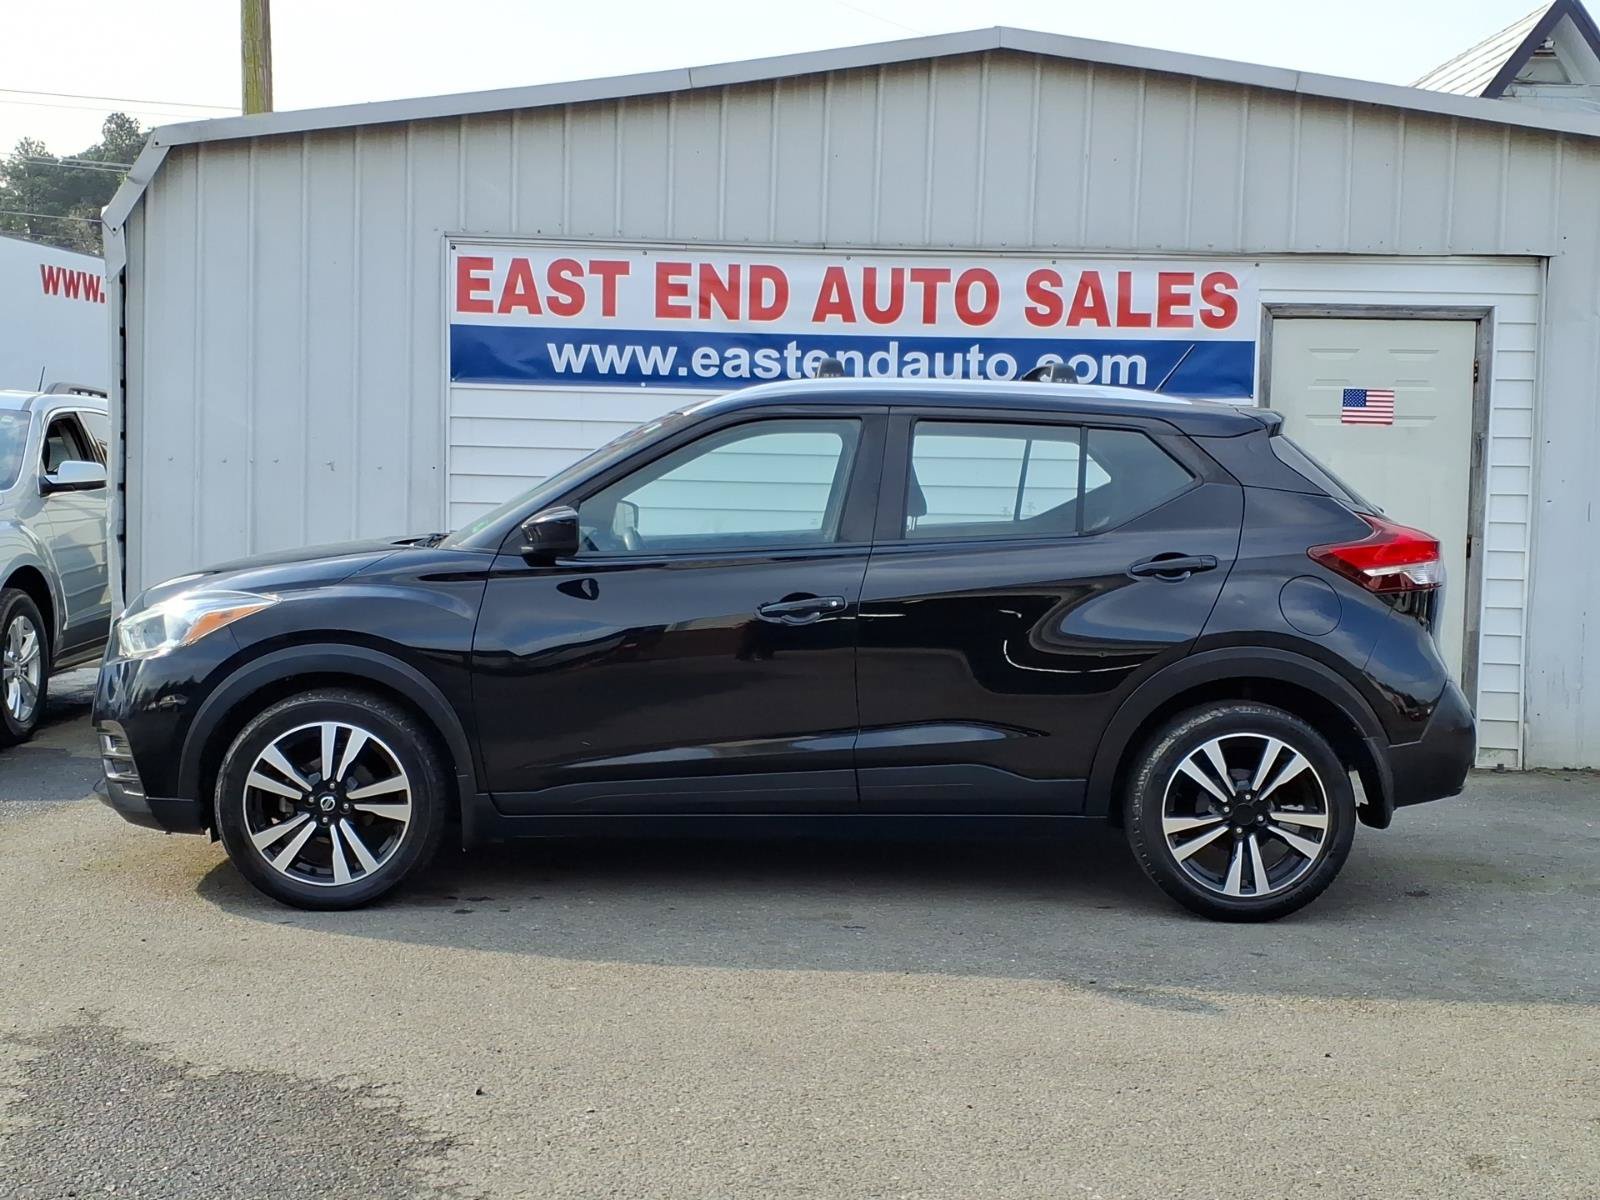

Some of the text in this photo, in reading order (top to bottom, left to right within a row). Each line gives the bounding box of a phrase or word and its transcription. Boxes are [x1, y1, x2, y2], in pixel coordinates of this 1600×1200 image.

[40, 264, 105, 304] WWW.
[455, 256, 1239, 330] EAST END AUTO SALES
[546, 340, 1147, 385] www.eastendautoom
